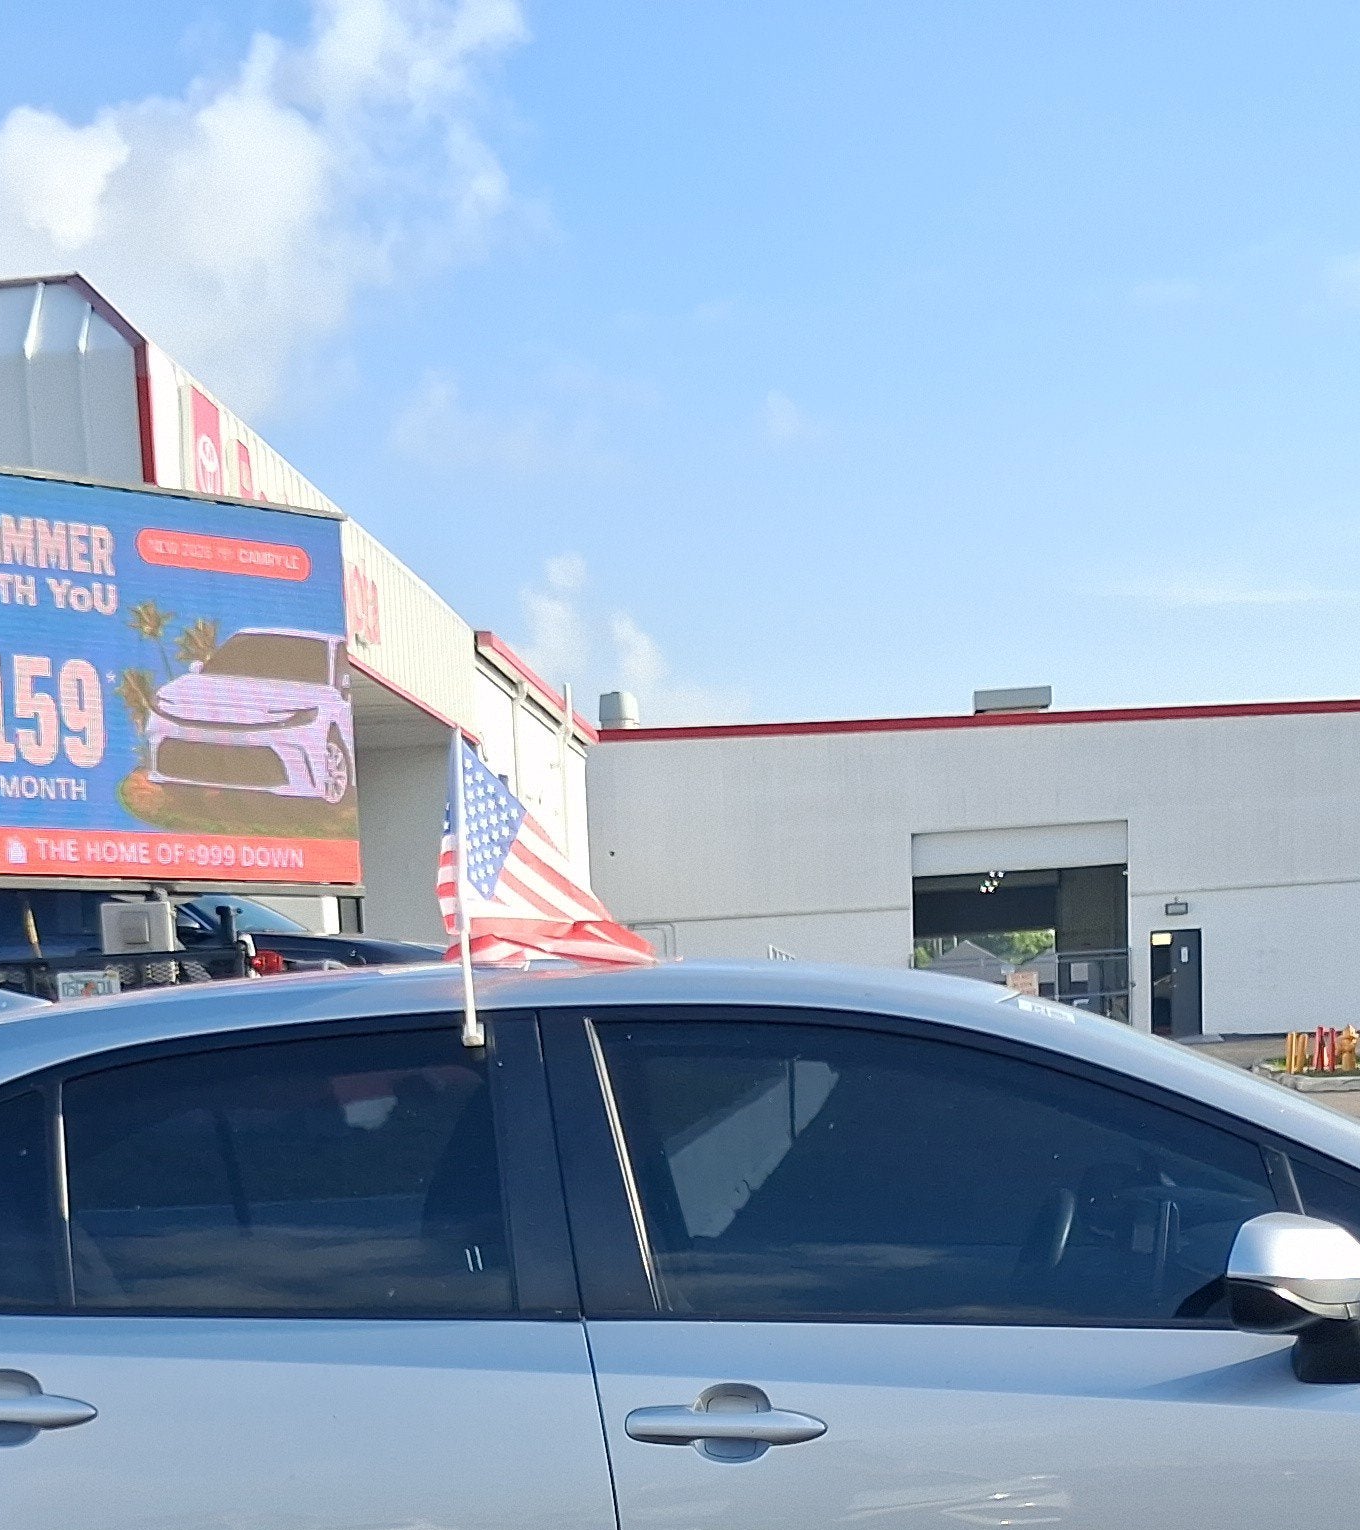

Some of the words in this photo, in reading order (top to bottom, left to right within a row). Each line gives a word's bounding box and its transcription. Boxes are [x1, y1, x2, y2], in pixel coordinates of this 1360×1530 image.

[35, 837, 79, 862] THE
[86, 839, 151, 865] HOME
[157, 842, 184, 865] OF
[240, 845, 304, 868] DOWN
